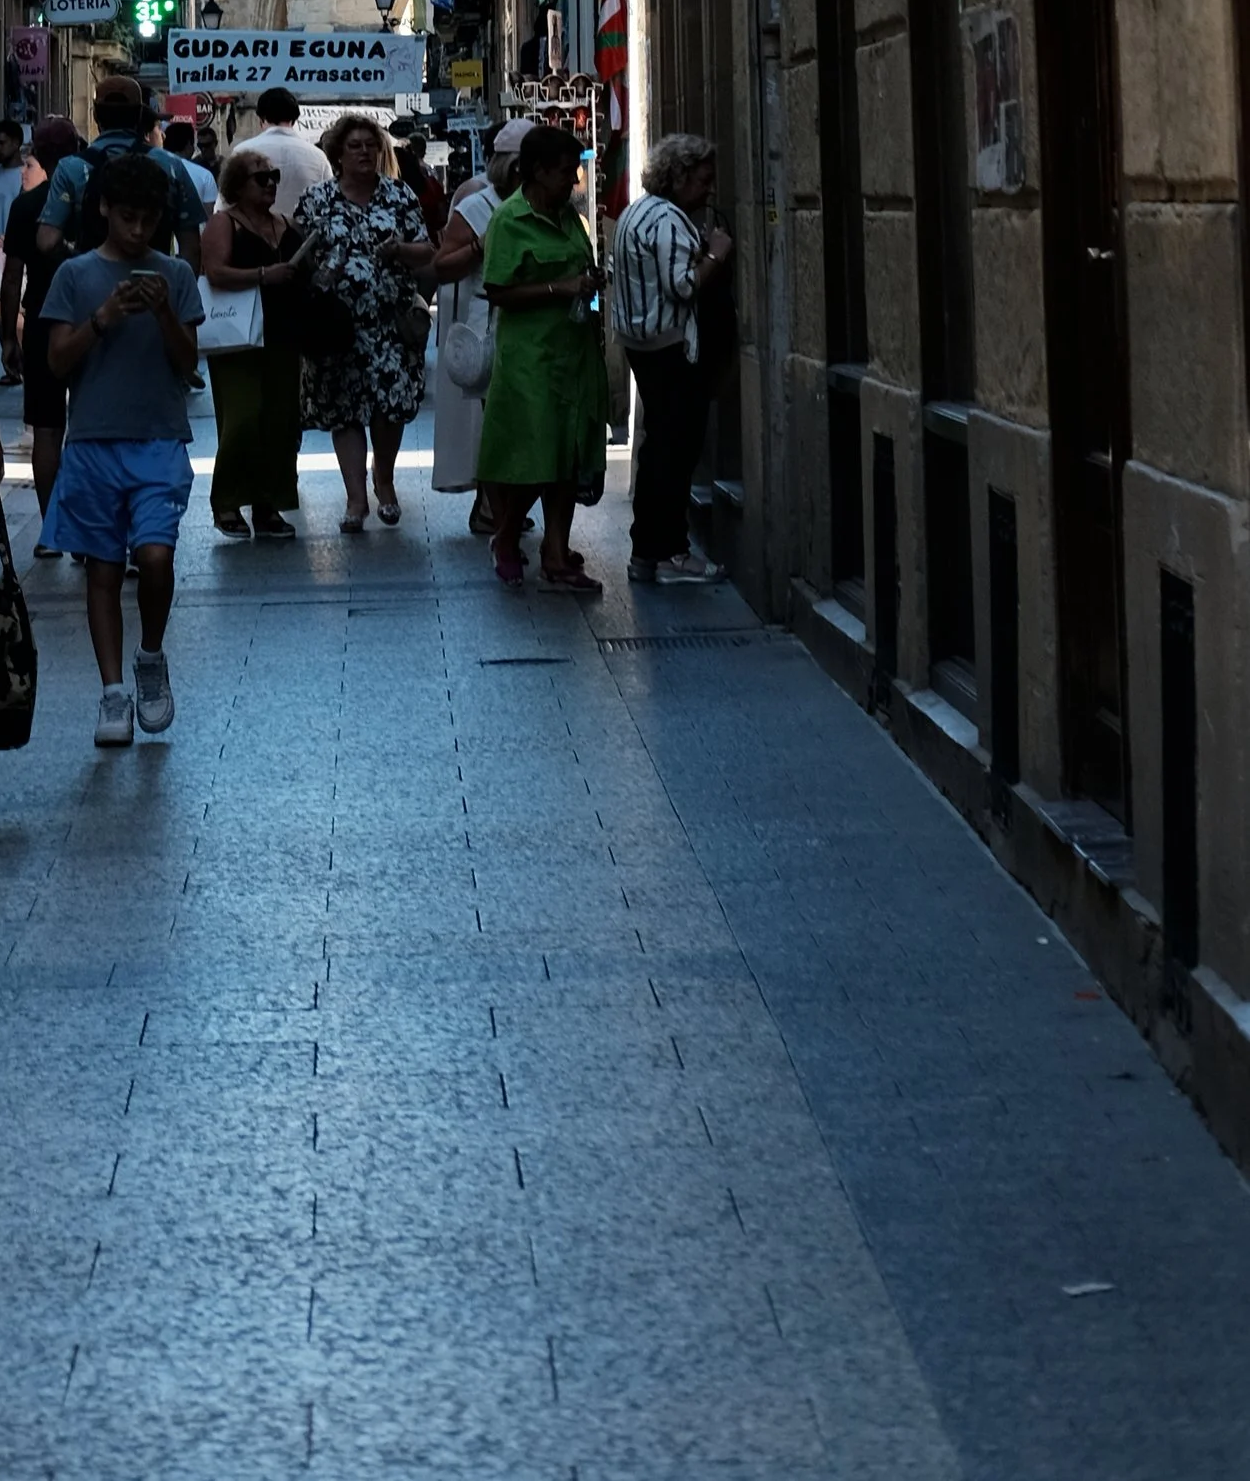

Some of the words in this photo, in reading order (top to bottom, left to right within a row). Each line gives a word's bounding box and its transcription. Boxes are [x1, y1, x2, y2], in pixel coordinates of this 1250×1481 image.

[173, 38, 278, 58] GUDARI
[289, 39, 386, 59] EGUNA
[176, 63, 238, 83] Irailak
[245, 66, 271, 82] 27
[284, 65, 385, 83] Arrasaten
